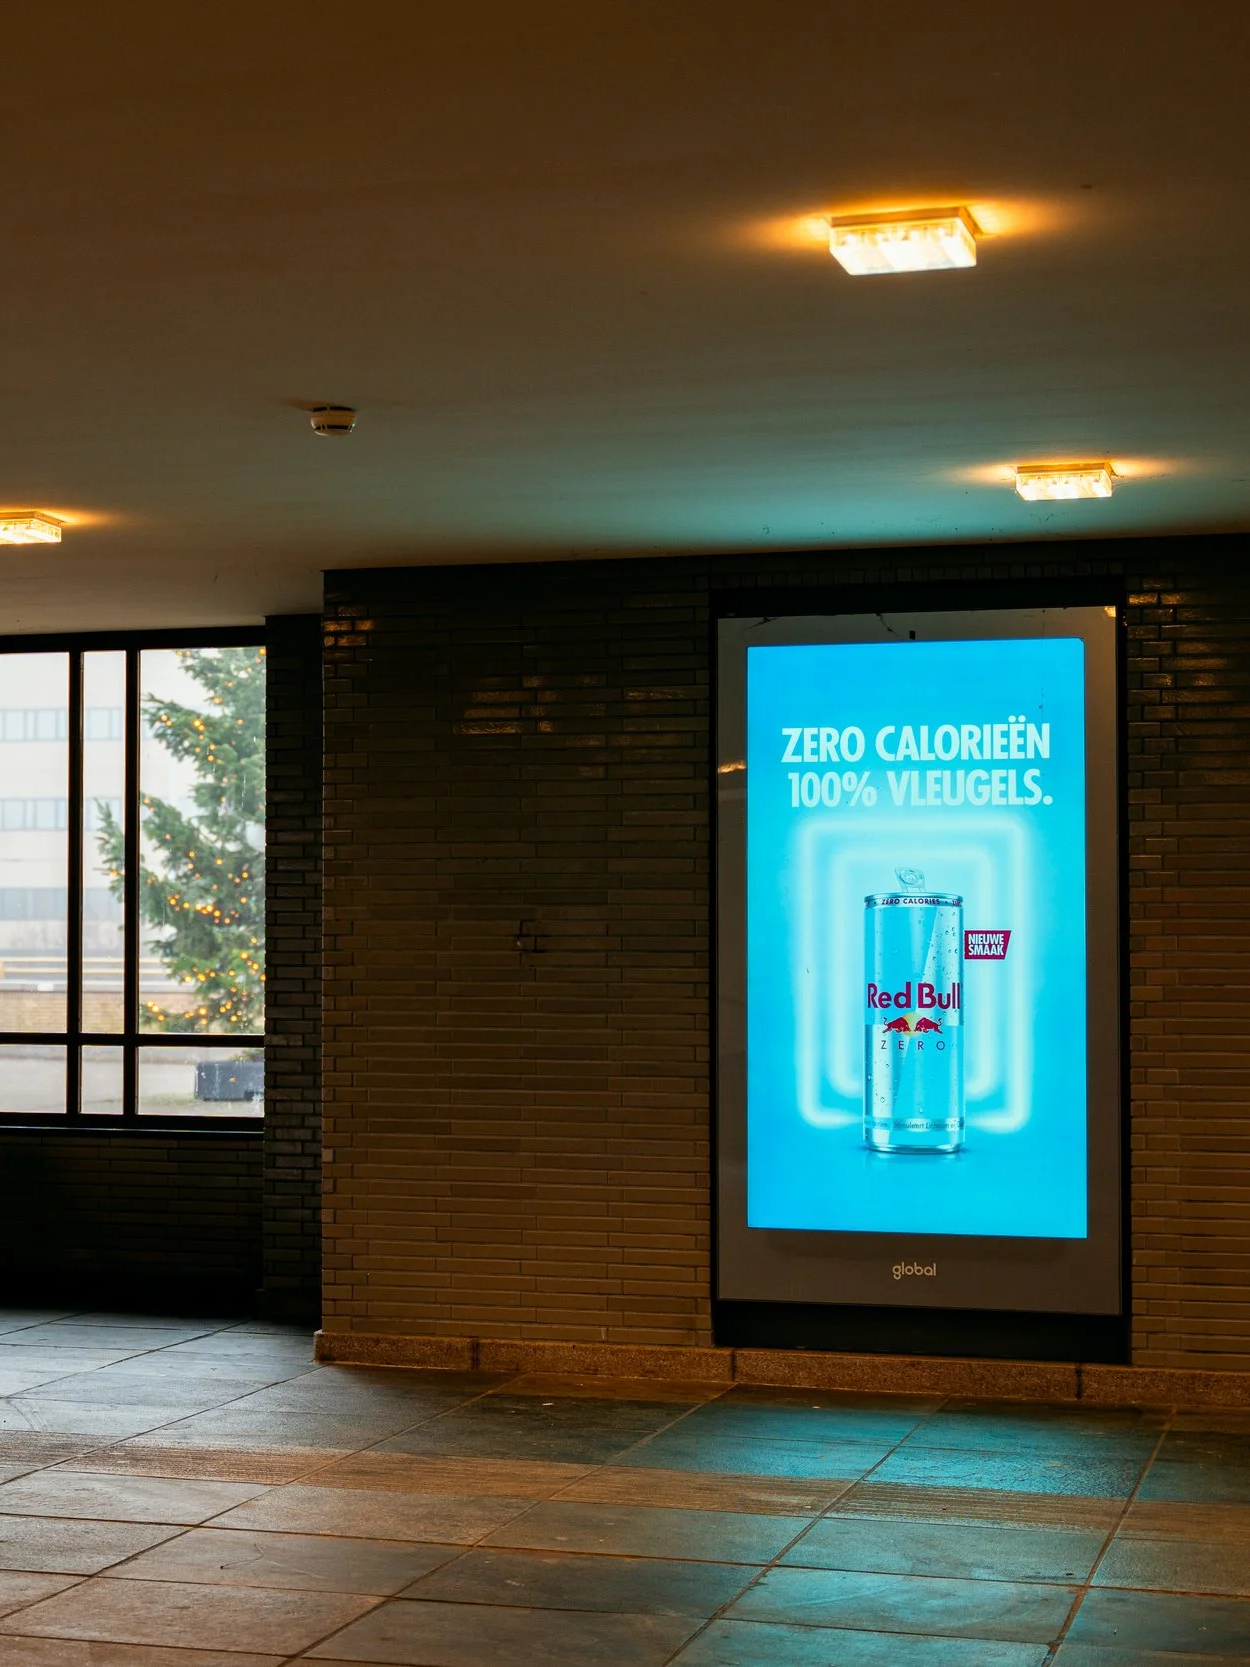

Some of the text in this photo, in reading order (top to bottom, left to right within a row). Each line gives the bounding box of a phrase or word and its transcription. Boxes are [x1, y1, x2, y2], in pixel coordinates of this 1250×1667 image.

[781, 715, 1050, 763] ZERO CALORIEËN
[788, 768, 1053, 807] 100% VLEUGELS.
[968, 933, 1004, 945] NIEUWE
[968, 944, 1004, 956] SMAAK
[867, 981, 961, 1009] Red Bull
[880, 1040, 946, 1051] ZERO
[892, 1261, 937, 1280] global
